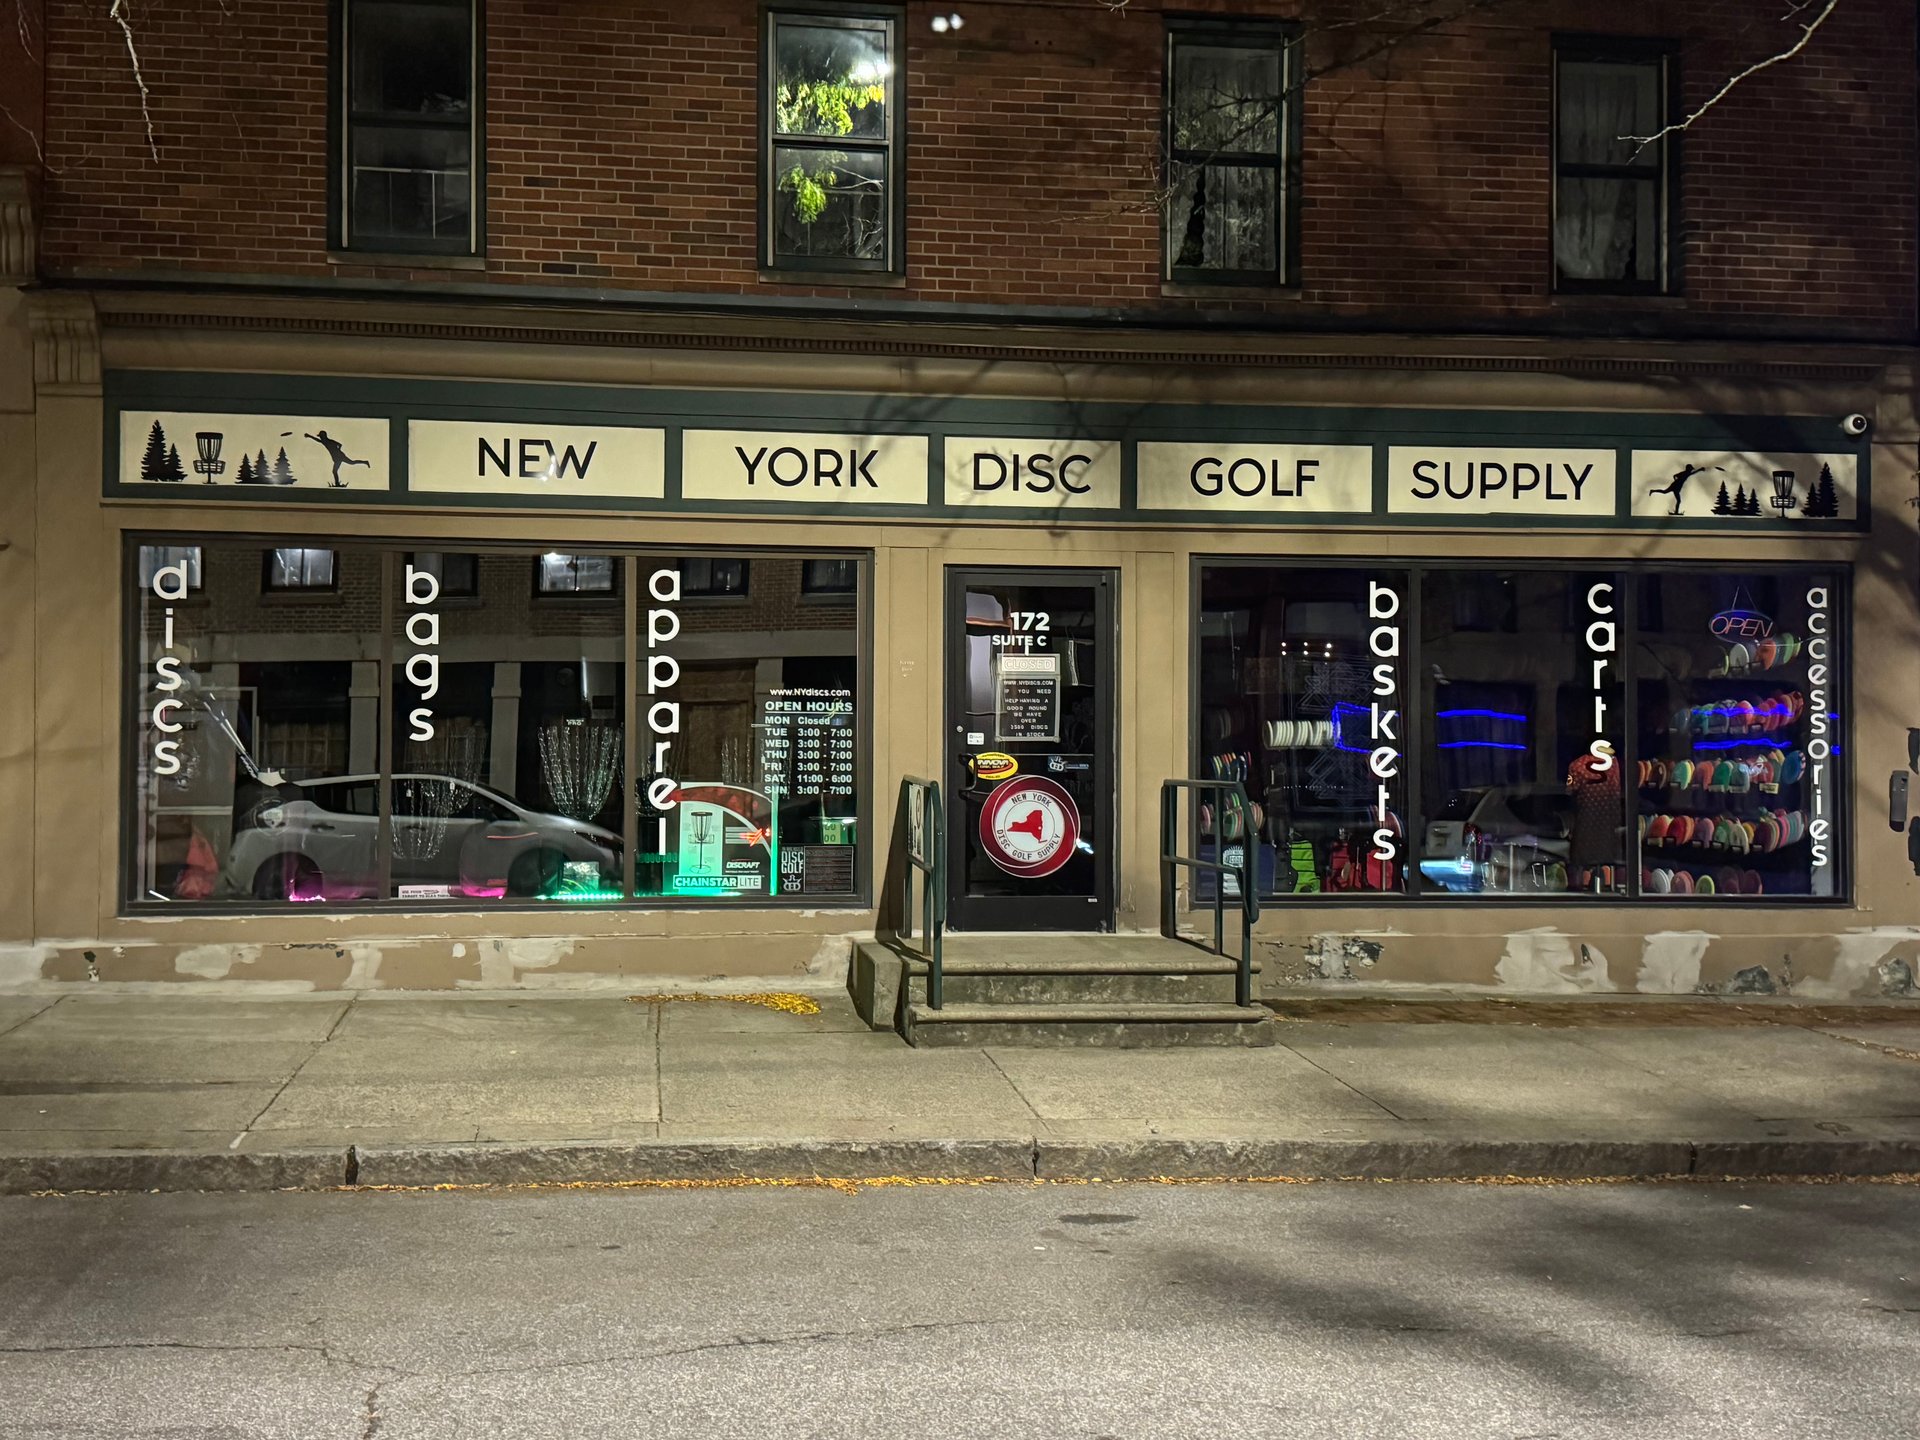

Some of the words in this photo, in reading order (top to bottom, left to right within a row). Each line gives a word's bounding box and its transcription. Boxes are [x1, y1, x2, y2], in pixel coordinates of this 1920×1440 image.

[477, 437, 598, 480] NEW
[734, 445, 879, 488] YORK
[972, 452, 1092, 494] DISC
[1190, 456, 1320, 497] GOLF
[1410, 460, 1594, 501] SUPPLY
[1010, 611, 1051, 632] 172
[1709, 615, 1774, 639] OPEN
[991, 634, 1034, 647] SUITE
[1036, 635, 1047, 647] C
[405, 564, 440, 741] bags
[152, 559, 184, 775] discs
[1004, 659, 1053, 670] CLOSED
[1585, 583, 1616, 772] carts
[769, 687, 851, 697] www.NYdiscs.com
[648, 569, 681, 856] apparel
[764, 701, 802, 711] OPEN
[806, 702, 853, 712] HOURS
[764, 716, 790, 725] MON
[797, 716, 831, 725] Closed
[1369, 581, 1400, 861] baskets
[1806, 586, 1830, 867] accessories
[764, 728, 788, 737] TUE
[797, 728, 820, 737] 3:00
[830, 728, 852, 737] 7:00
[764, 740, 790, 749] WED
[797, 740, 820, 749] 3:00
[830, 740, 852, 749] 7:00
[764, 751, 787, 760] THU
[797, 751, 820, 760] 3:00
[830, 751, 852, 760] 7:00
[764, 762, 782, 771] FRI
[797, 762, 820, 771] 3:00
[829, 762, 852, 771] 7:00
[764, 774, 786, 783] SAT
[797, 774, 823, 783] 11:00
[831, 774, 852, 783] 6:00
[764, 786, 787, 795] SUN
[797, 786, 819, 795] 3:00
[829, 786, 852, 795] 7:00
[1011, 793, 1027, 805] NEW
[1032, 793, 1052, 807] YORK
[996, 829, 1011, 850] DISC
[1011, 849, 1032, 861] GOLF
[1037, 833, 1061, 859] SUPPLY
[781, 851, 804, 863] DISC
[781, 863, 804, 874] GOLF
[675, 877, 738, 887] CHAINSTAR
[740, 877, 760, 887] LITE
